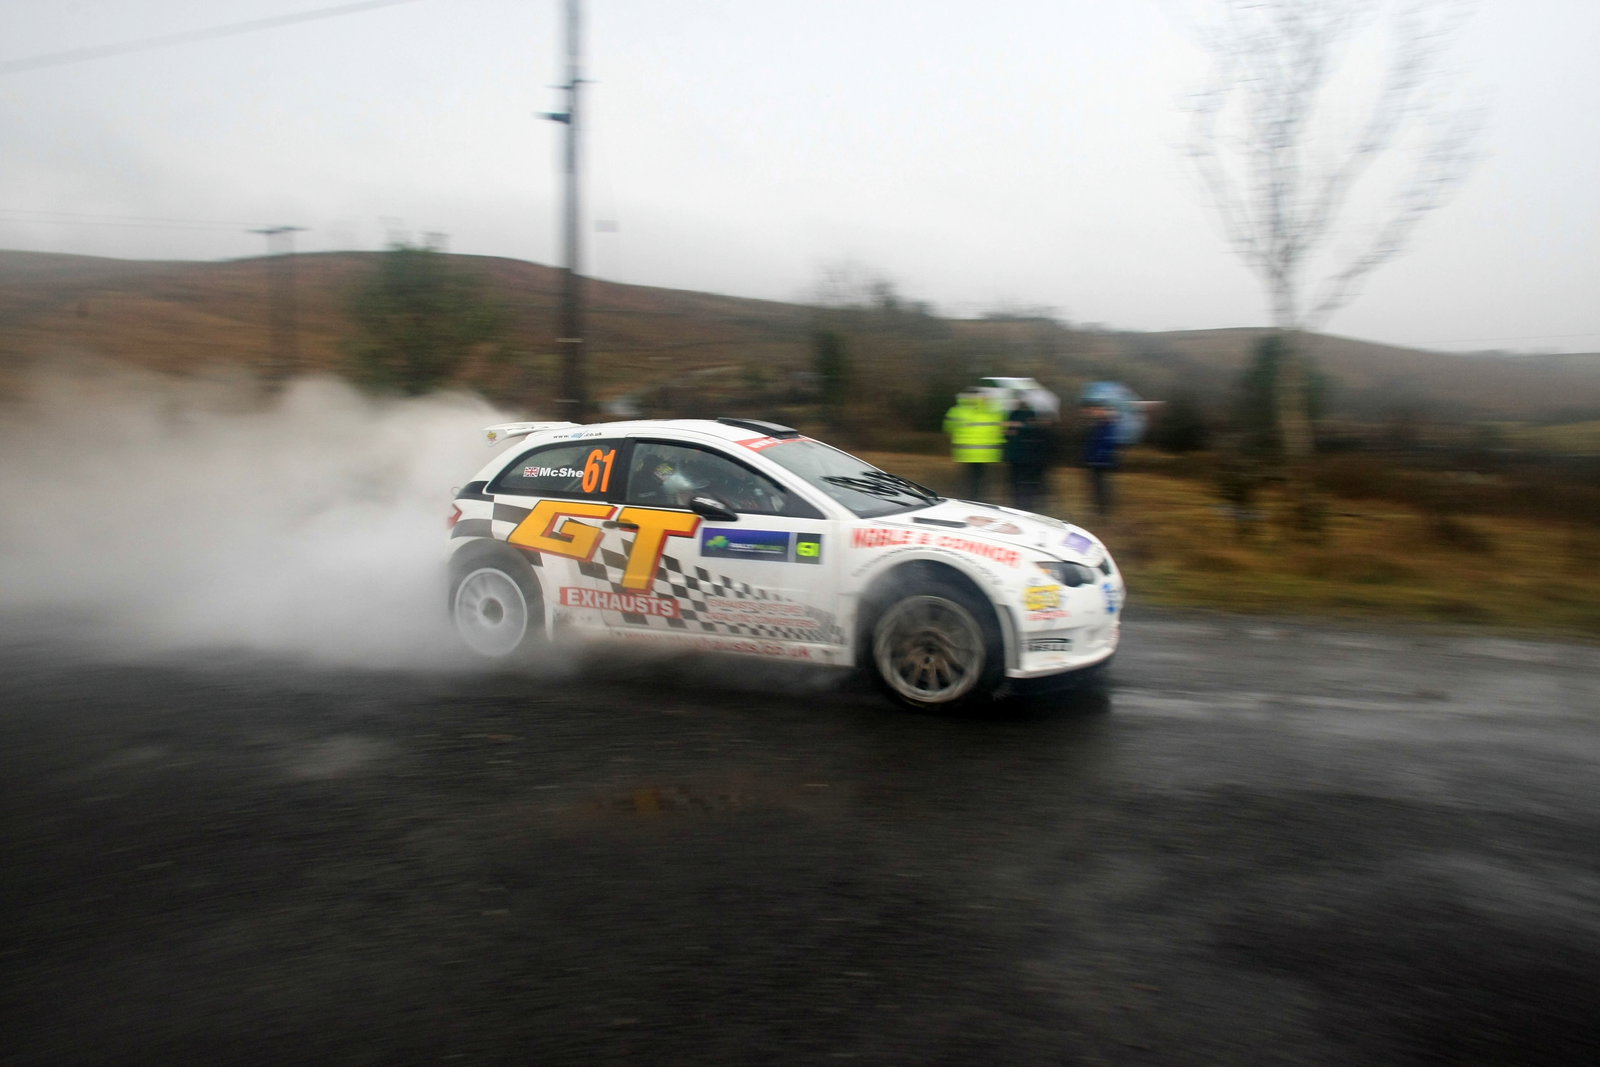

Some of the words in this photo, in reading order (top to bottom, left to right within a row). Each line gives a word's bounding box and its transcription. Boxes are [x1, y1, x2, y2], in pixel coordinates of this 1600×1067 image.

[582, 449, 616, 493] 61
[507, 500, 703, 595] GT
[566, 588, 674, 617] EXHAUSTS
